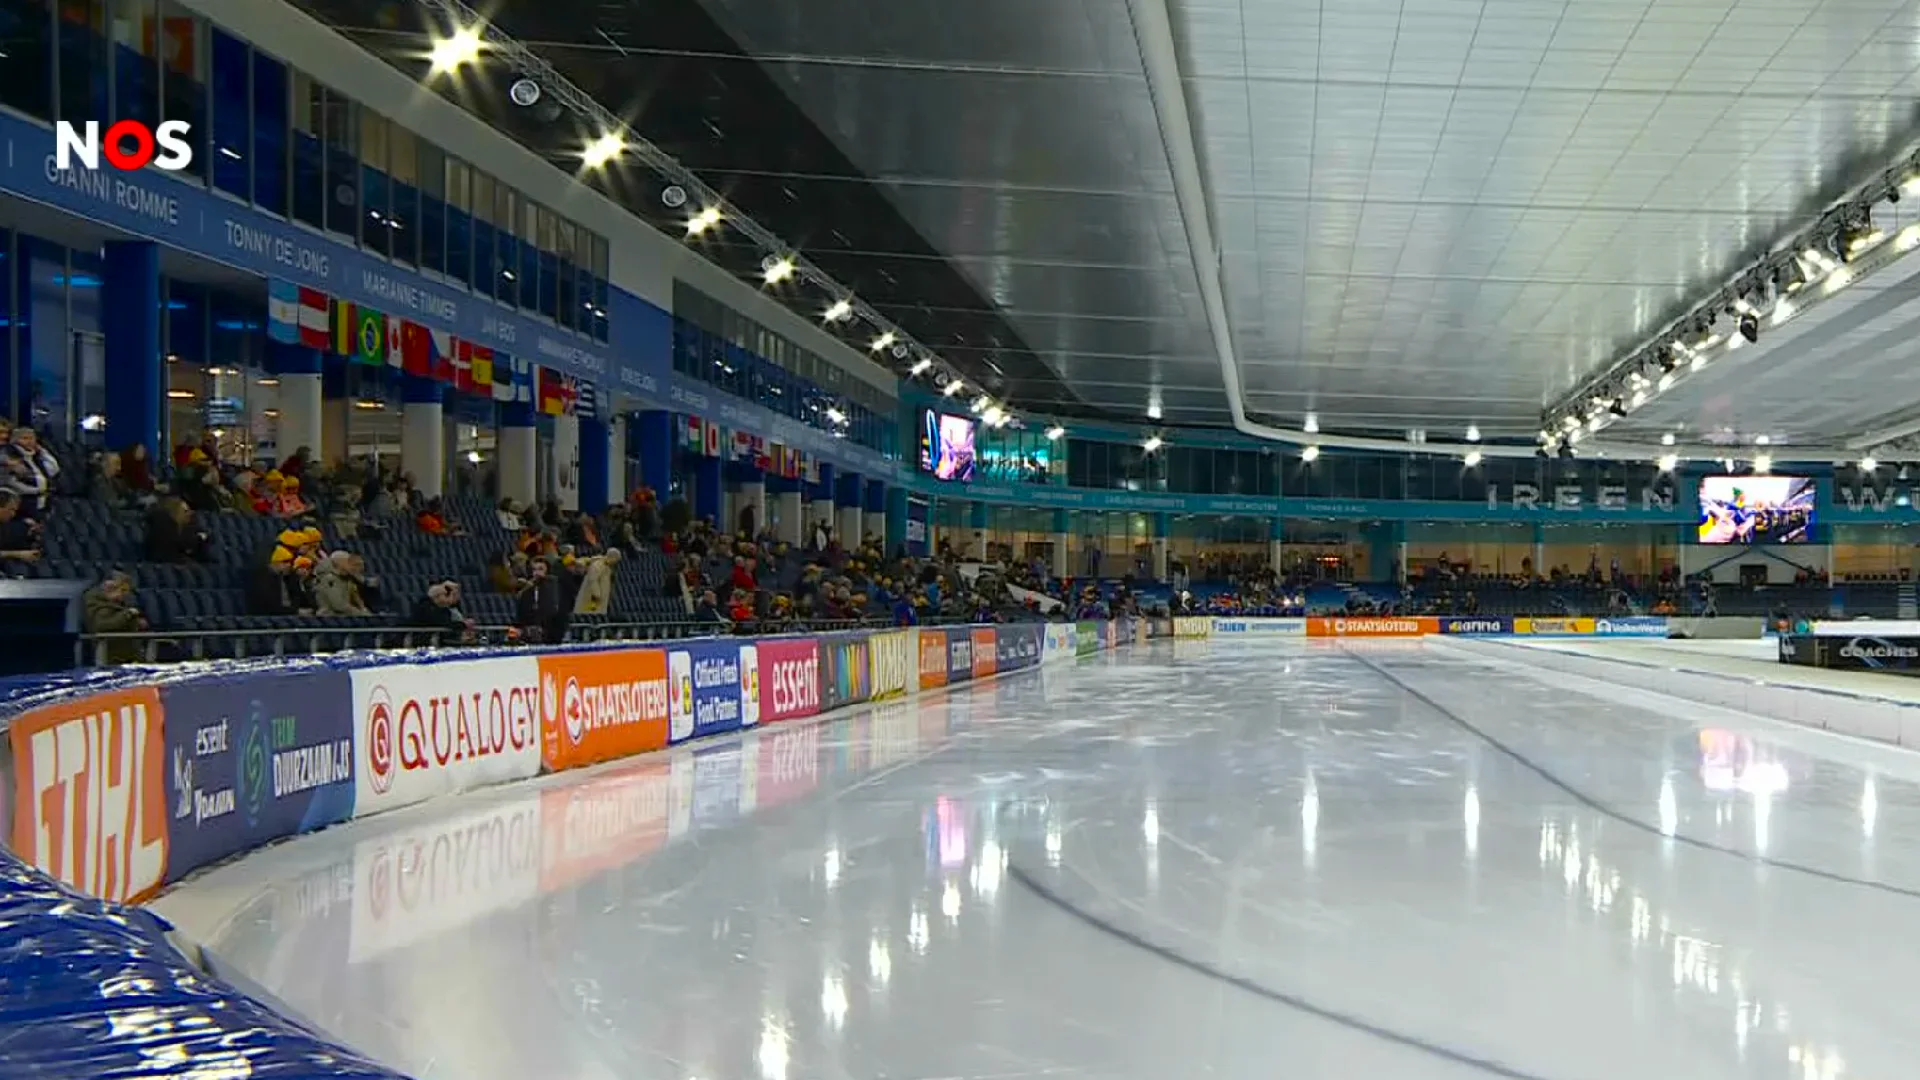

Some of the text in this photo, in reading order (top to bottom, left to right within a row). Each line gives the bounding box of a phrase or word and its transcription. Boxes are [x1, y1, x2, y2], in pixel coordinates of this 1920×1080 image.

[45, 154, 179, 226] GIANNI ROMME
[224, 220, 329, 278] TONNY DE JONG
[363, 268, 419, 309] MARIANNE
[1486, 484, 1674, 512] IREEN
[771, 648, 819, 713] essent
[1840, 646, 1918, 657] COACHES
[399, 686, 538, 770] QUALOGY
